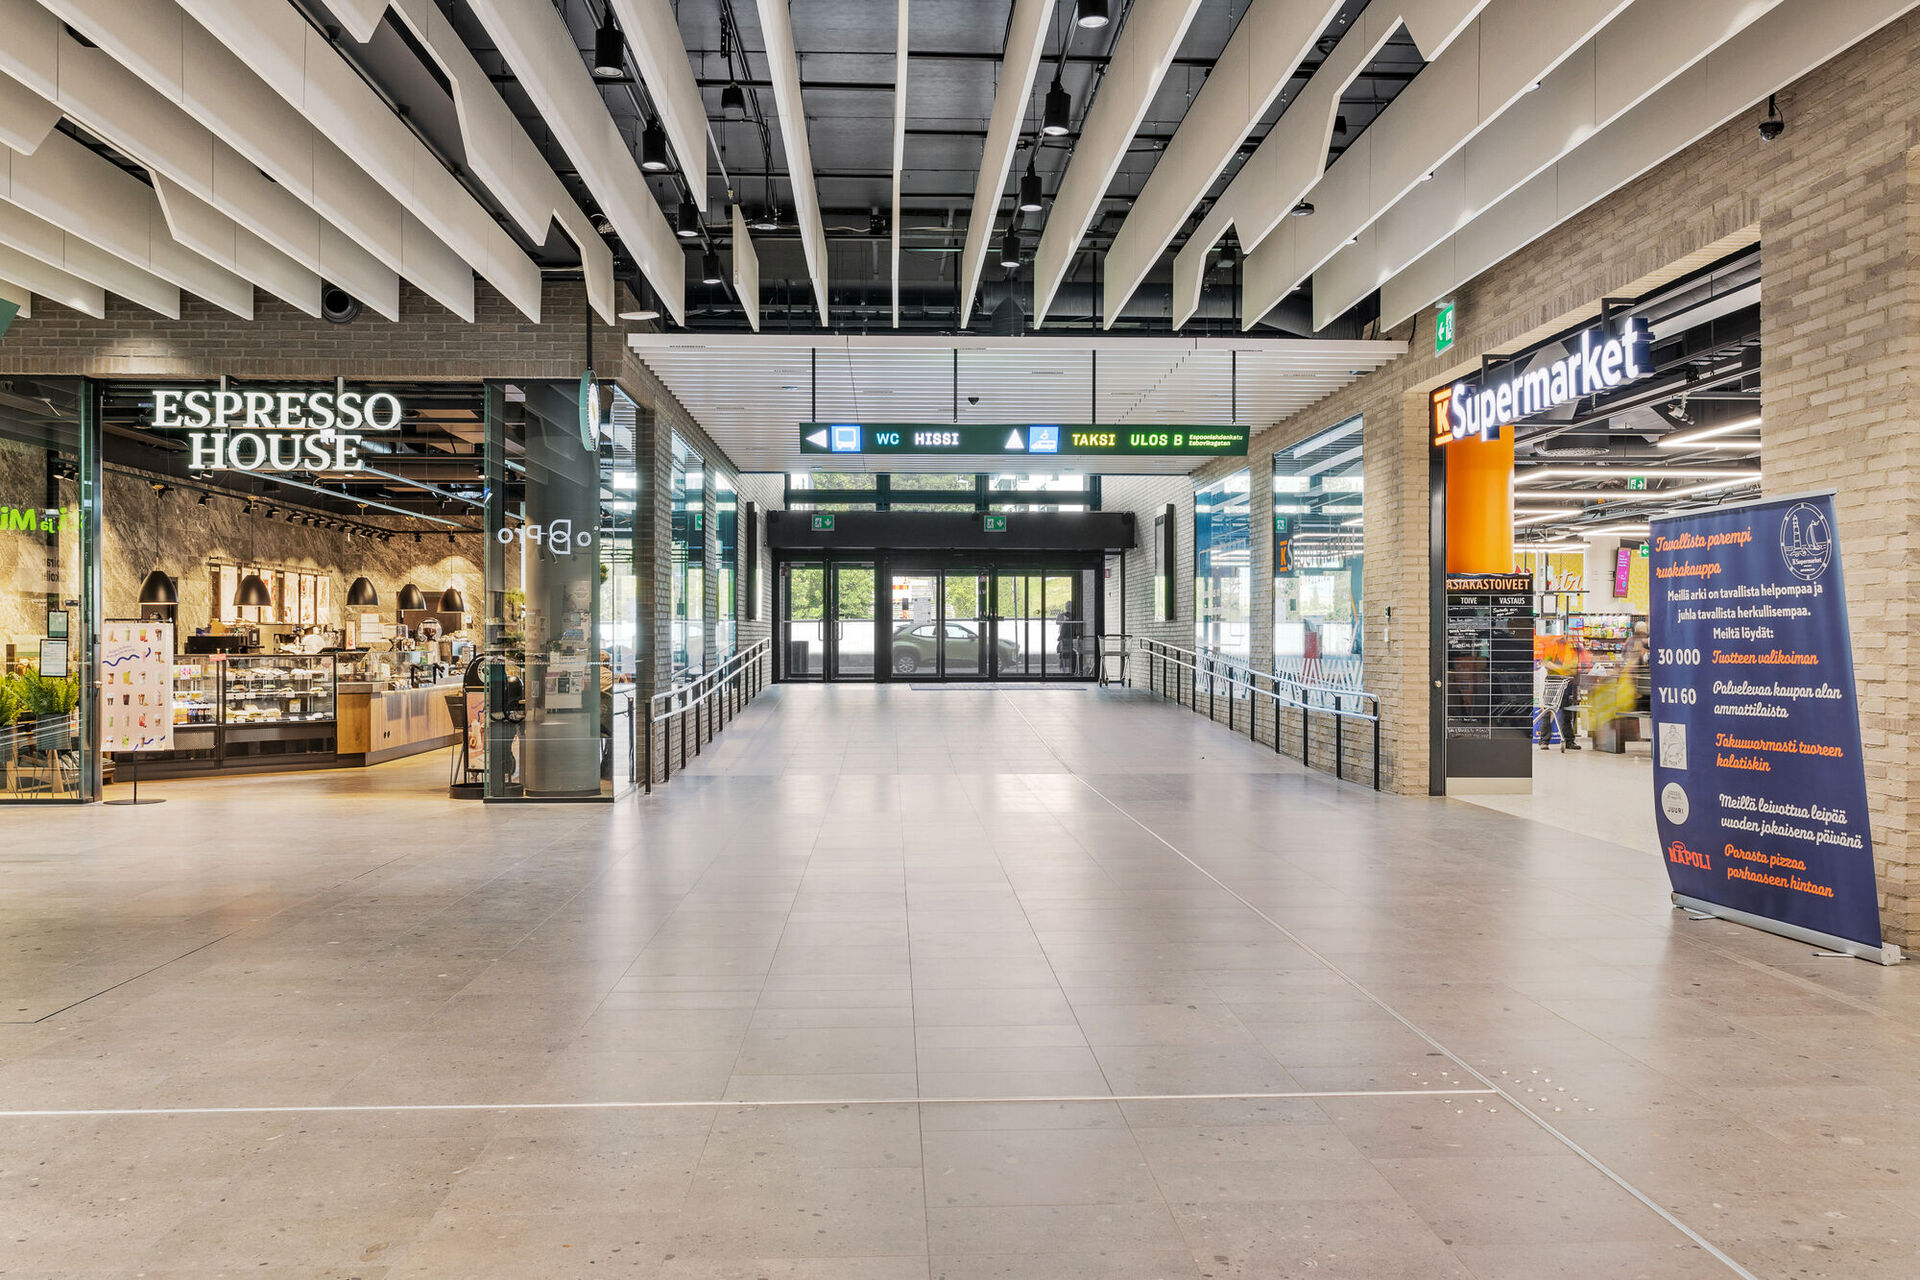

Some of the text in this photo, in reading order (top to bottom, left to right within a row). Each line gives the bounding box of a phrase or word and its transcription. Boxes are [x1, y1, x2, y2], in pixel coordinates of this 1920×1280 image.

[1452, 317, 1639, 442] Supermarket
[152, 390, 401, 430] ESPRESSO
[876, 432, 960, 446] WC HISSI
[1072, 433, 1116, 446] TAKSI
[1130, 433, 1168, 446] ULOS
[1173, 433, 1183, 446] B
[188, 432, 363, 470] HOUSE
[1655, 526, 1752, 552] Tavallista parempi
[1655, 560, 1722, 580] ruokakauppa
[1446, 578, 1530, 590] ASIAKASTOIVEET
[1667, 581, 1823, 602] Meillä arki on tavallista helpompaa ja
[1461, 596, 1526, 605] TOIVE VASTAUS
[1677, 605, 1812, 624] juhla tavallista herkullisempaa.
[1713, 626, 1774, 642] Meiltä löydät:
[1658, 648, 1701, 666] 30 000
[1711, 649, 1819, 665] Tuotteen valikoiman
[1658, 687, 1697, 705] YLI 60
[1712, 680, 1842, 701] Palvelevaa kaupan alan
[1713, 701, 1790, 719] ammattilaista
[1715, 732, 1844, 758] Takuuvarmasti tuoreen
[1716, 753, 1771, 772] kalatiskin
[1719, 793, 1848, 826] Meillä leivottua leipää
[1721, 816, 1864, 850] vuoden jokaisena päivänä
[1724, 843, 1807, 871] Parasta pizzaa
[1727, 866, 1835, 898] parhaaseen hintaan
